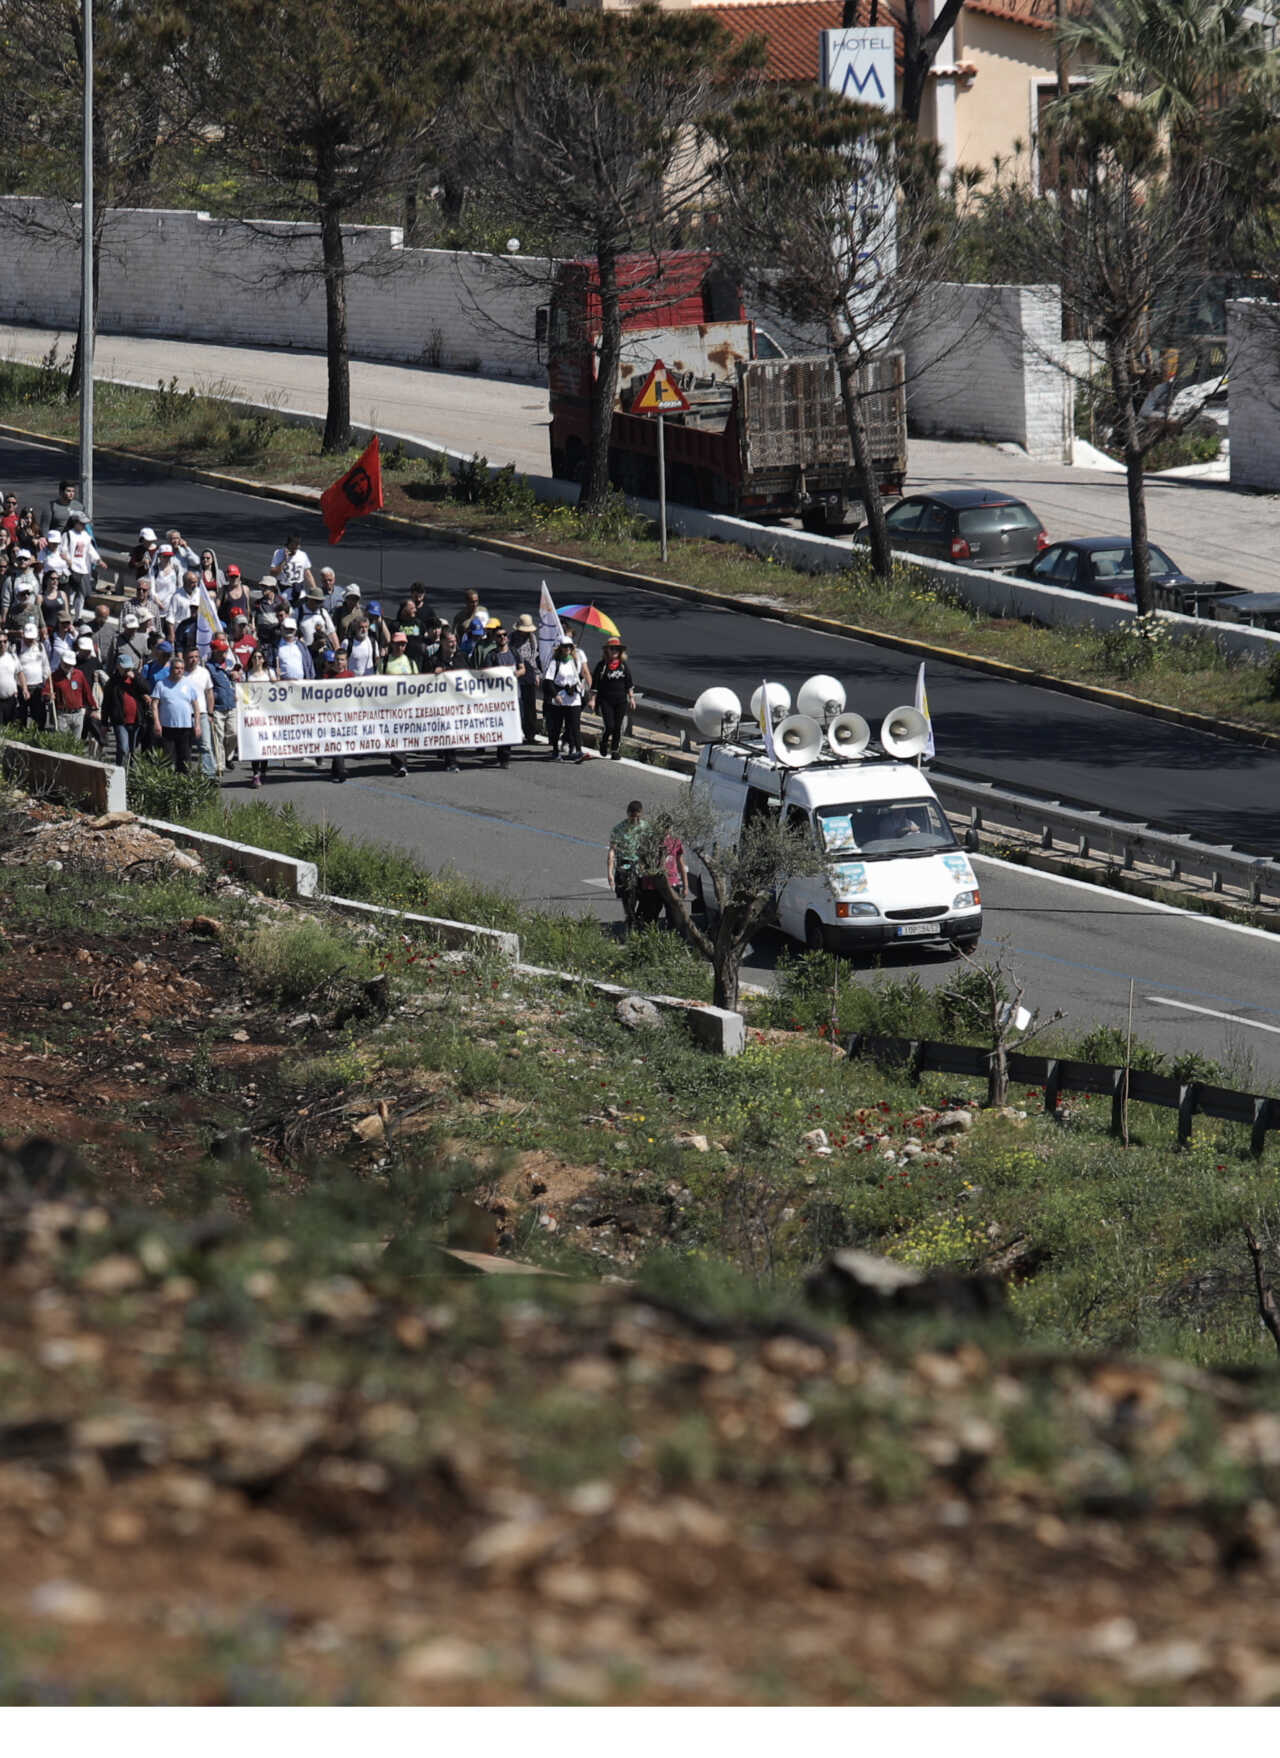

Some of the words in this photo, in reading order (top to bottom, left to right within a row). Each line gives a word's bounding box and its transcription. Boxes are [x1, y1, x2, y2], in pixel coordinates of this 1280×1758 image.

[833, 38, 891, 51] HOTEL
[301, 682, 388, 702] Μαραθώνια
[455, 674, 514, 695] Ειρήνης
[268, 712, 315, 726] ΣΥΜΜΕΤΟΧΗ
[318, 711, 342, 723] ΣΤΟΥΣ
[344, 707, 413, 722] ΙΜΠΕΡΙΑΛΙΣΤΙΚΟΥΣ
[415, 704, 464, 719] ΣΧΕΔΙΑΣΜΟΥΣ
[473, 700, 516, 715] ΠΟΛΕΜΟΥΣ
[258, 731, 268, 741] ΝΑ
[272, 728, 312, 741] ΚΛΕΙΣΟΥΝ
[317, 727, 326, 738] ΟΙ
[331, 725, 358, 737] ΒΑΣΕΙΣ
[362, 724, 375, 734] ΚΑΙ
[379, 723, 390, 734] ΤΑ
[454, 716, 504, 730] ΣΤΡΑΤΗΓΕΙΑ
[262, 742, 319, 756] ΑΠΟΔΕΣΜΕΥΣΗ
[324, 741, 341, 752] ΑΠΟ
[345, 740, 355, 751] ΤΟ
[360, 739, 381, 749] ΝΑΤΟ
[385, 737, 398, 748] ΚΑΙ
[403, 736, 419, 747] ΤΗΝ
[474, 732, 503, 744] ΕΝΩΣΗ
